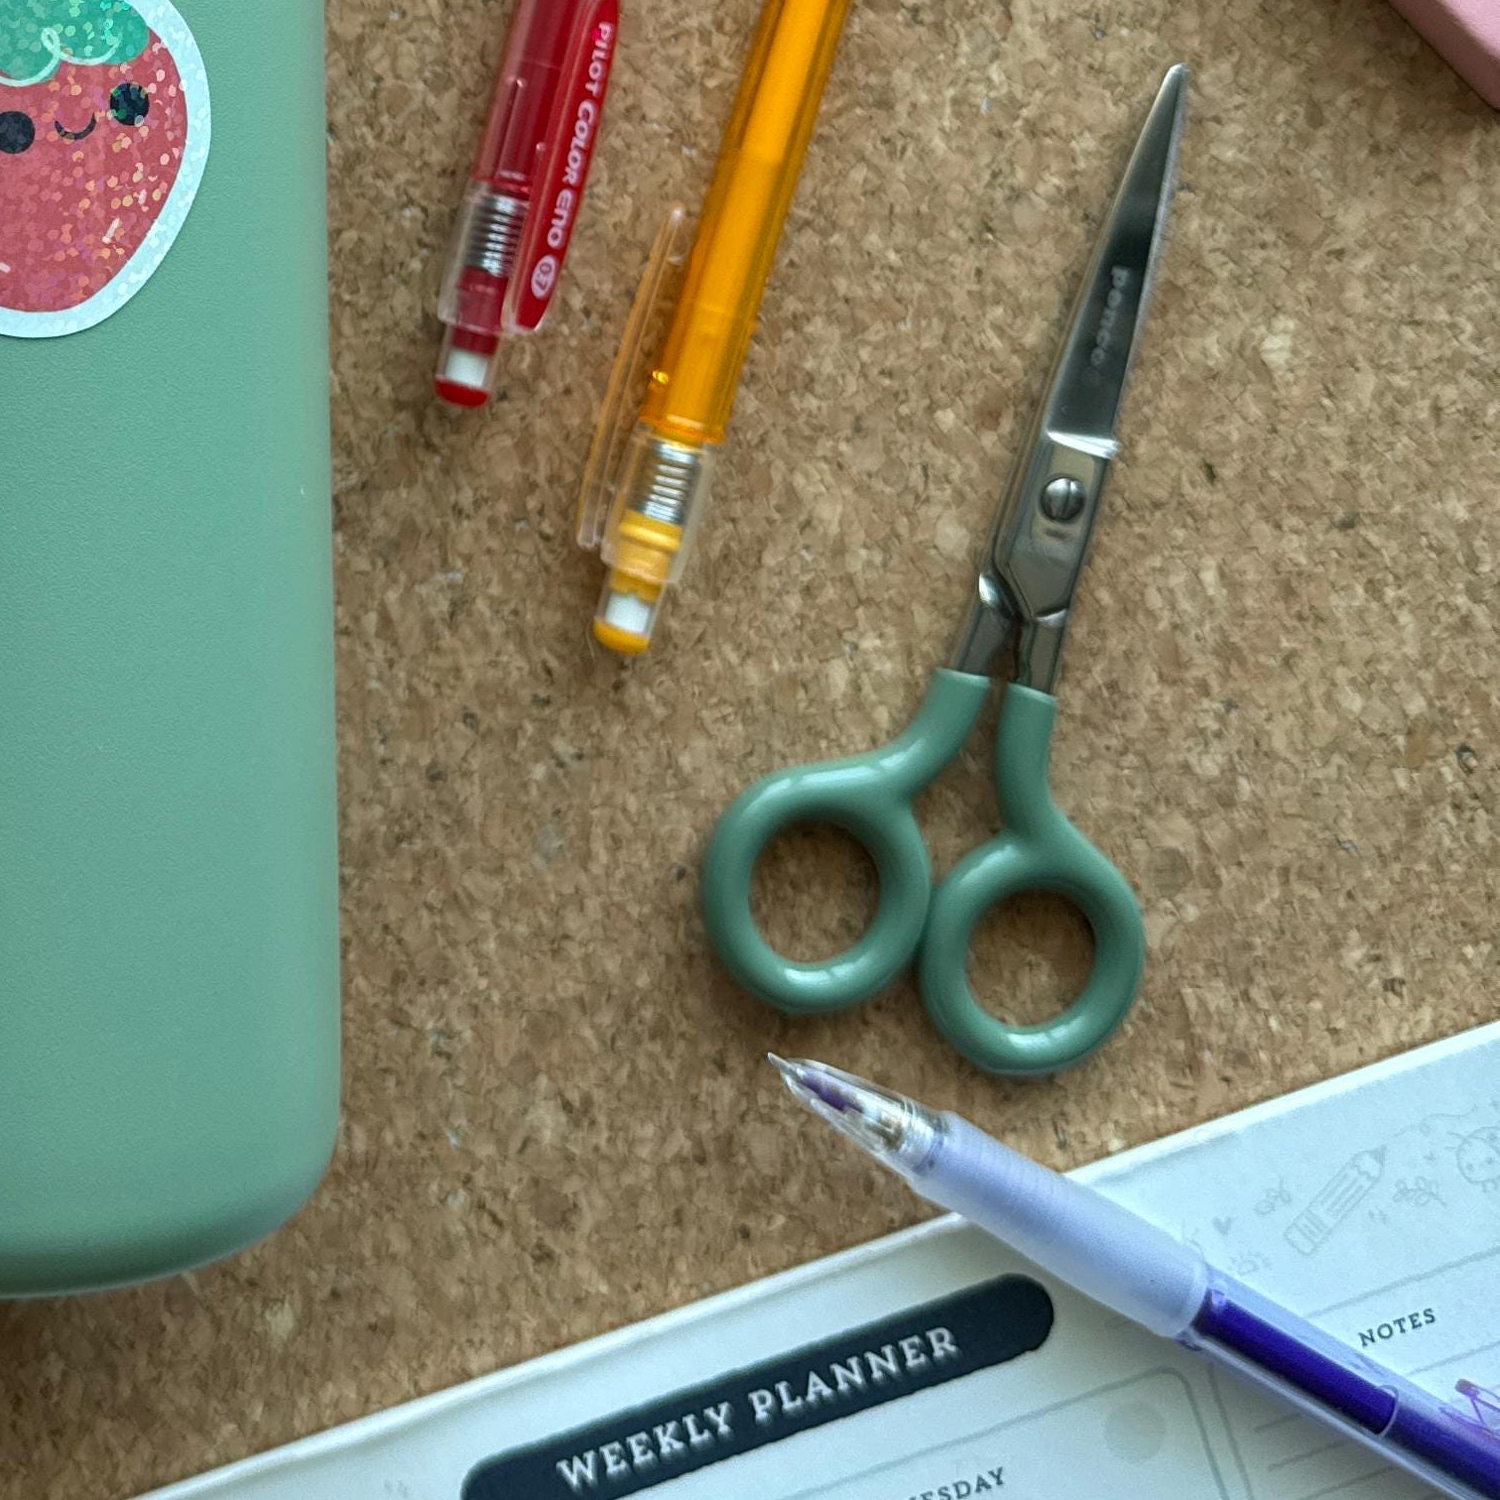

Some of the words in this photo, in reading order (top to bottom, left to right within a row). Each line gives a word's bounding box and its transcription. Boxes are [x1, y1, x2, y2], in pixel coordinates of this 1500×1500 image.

[585, 21, 614, 98] PILOT
[562, 100, 596, 185] COLOR
[1358, 1308, 1437, 1348] NOTES
[556, 1402, 734, 1493] WEEKLY
[748, 1327, 961, 1422] PLANNER
